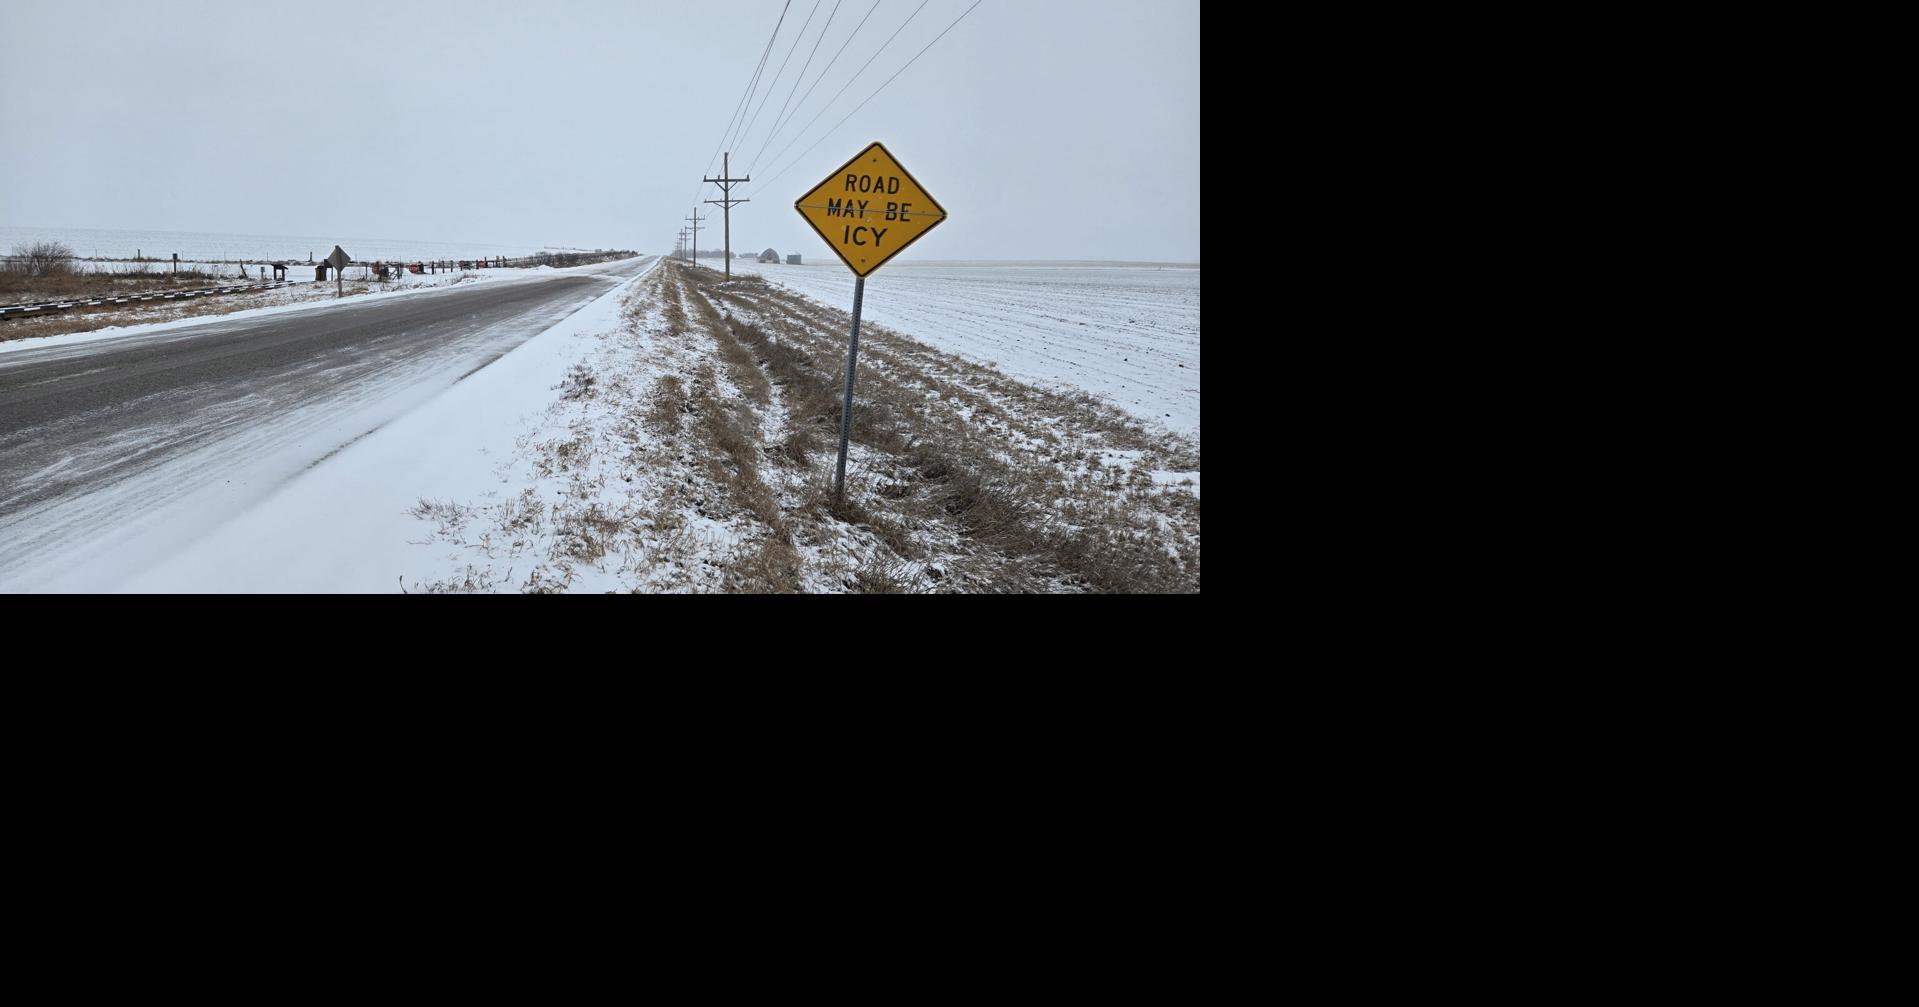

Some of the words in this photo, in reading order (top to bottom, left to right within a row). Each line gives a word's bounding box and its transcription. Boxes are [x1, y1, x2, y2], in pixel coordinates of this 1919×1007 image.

[845, 174, 900, 195] ROAD
[827, 197, 869, 219] MAY
[885, 202, 912, 222] BE
[843, 225, 888, 247] ICY
